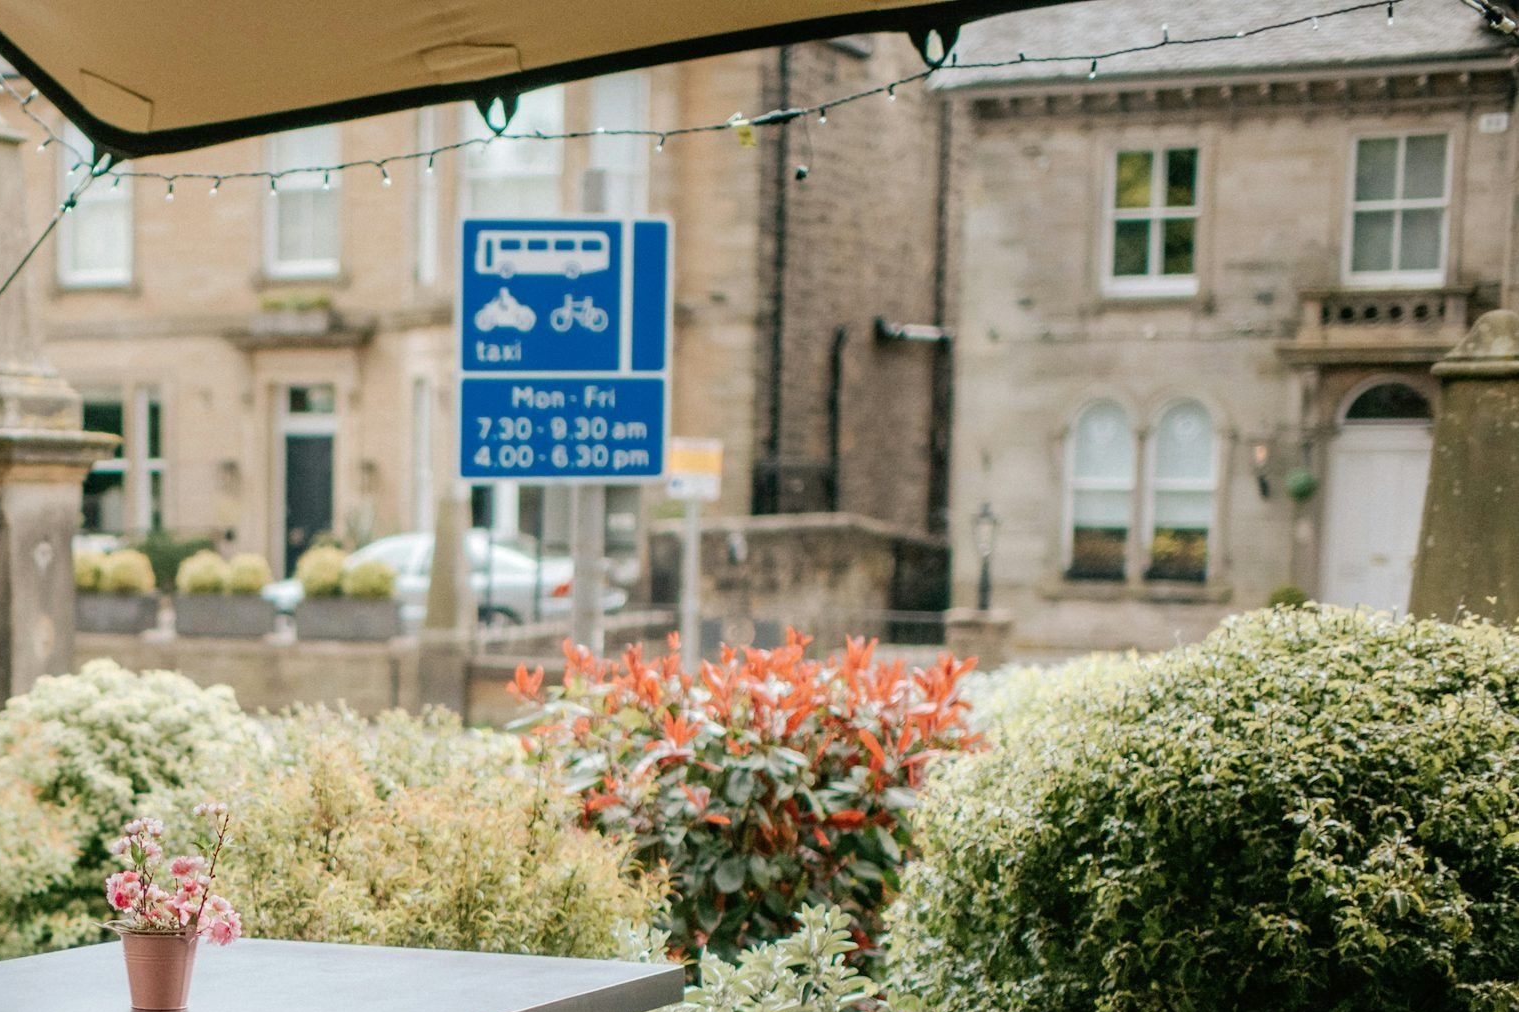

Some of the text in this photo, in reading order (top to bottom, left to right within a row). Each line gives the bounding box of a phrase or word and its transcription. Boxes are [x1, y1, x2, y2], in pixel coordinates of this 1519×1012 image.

[476, 340, 522, 362] taxi
[512, 385, 565, 409] Mon
[584, 385, 616, 409] Fri
[476, 416, 532, 440] 7.30
[611, 421, 648, 440] am
[474, 444, 534, 468] 4.00
[551, 444, 609, 468] 6.30
[612, 449, 649, 470] pm
